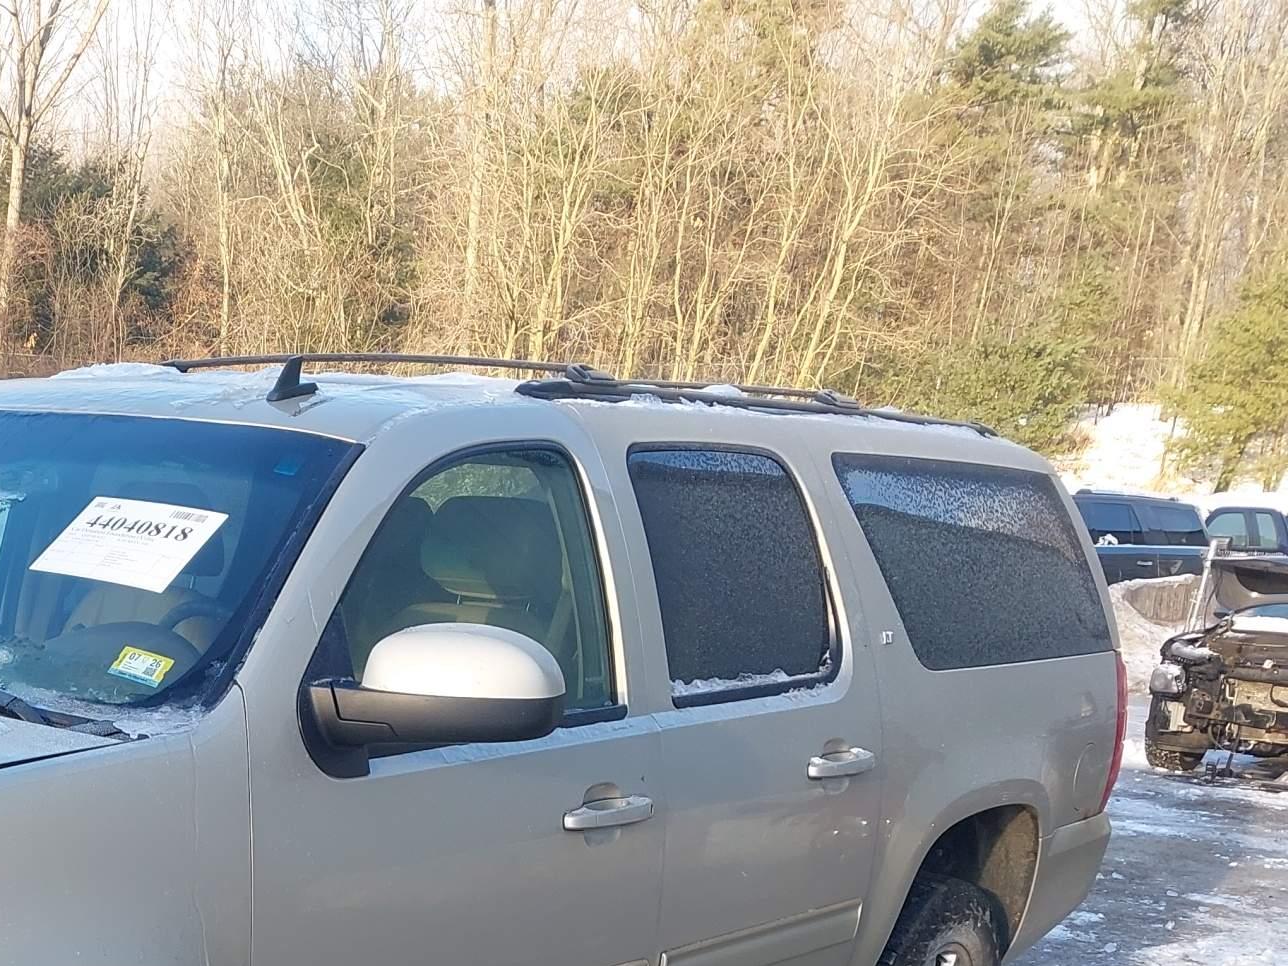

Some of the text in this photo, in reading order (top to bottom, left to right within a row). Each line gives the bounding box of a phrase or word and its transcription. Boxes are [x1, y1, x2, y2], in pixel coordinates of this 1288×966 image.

[85, 514, 194, 542] 44040818
[128, 652, 142, 662] 07
[150, 658, 162, 669] 26
